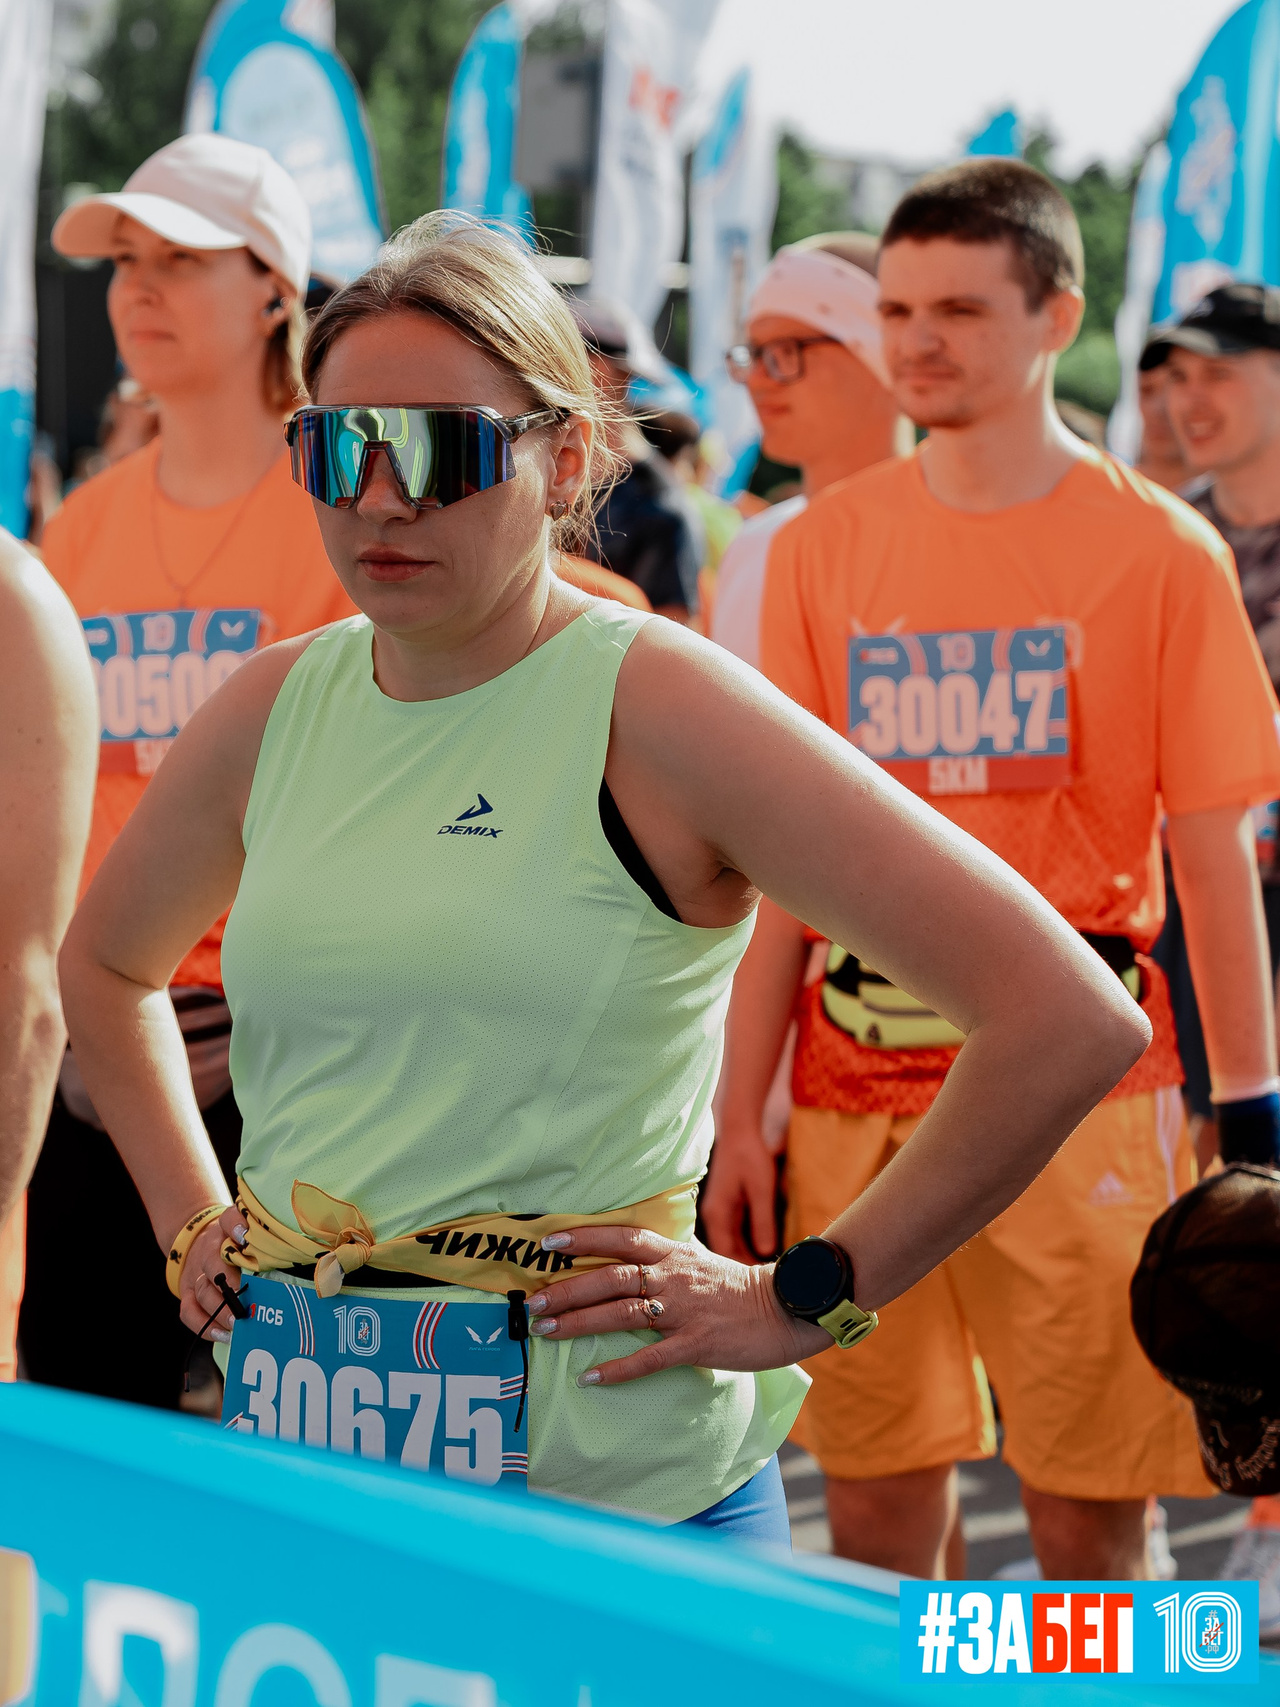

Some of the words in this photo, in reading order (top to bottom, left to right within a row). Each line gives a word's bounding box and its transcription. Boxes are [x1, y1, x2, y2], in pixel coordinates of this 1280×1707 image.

[92, 652, 238, 738] 050
[860, 671, 1054, 757] 30047
[437, 825, 503, 838] DEMIX
[333, 1305, 380, 1357] 10
[237, 1349, 503, 1487] 30675
